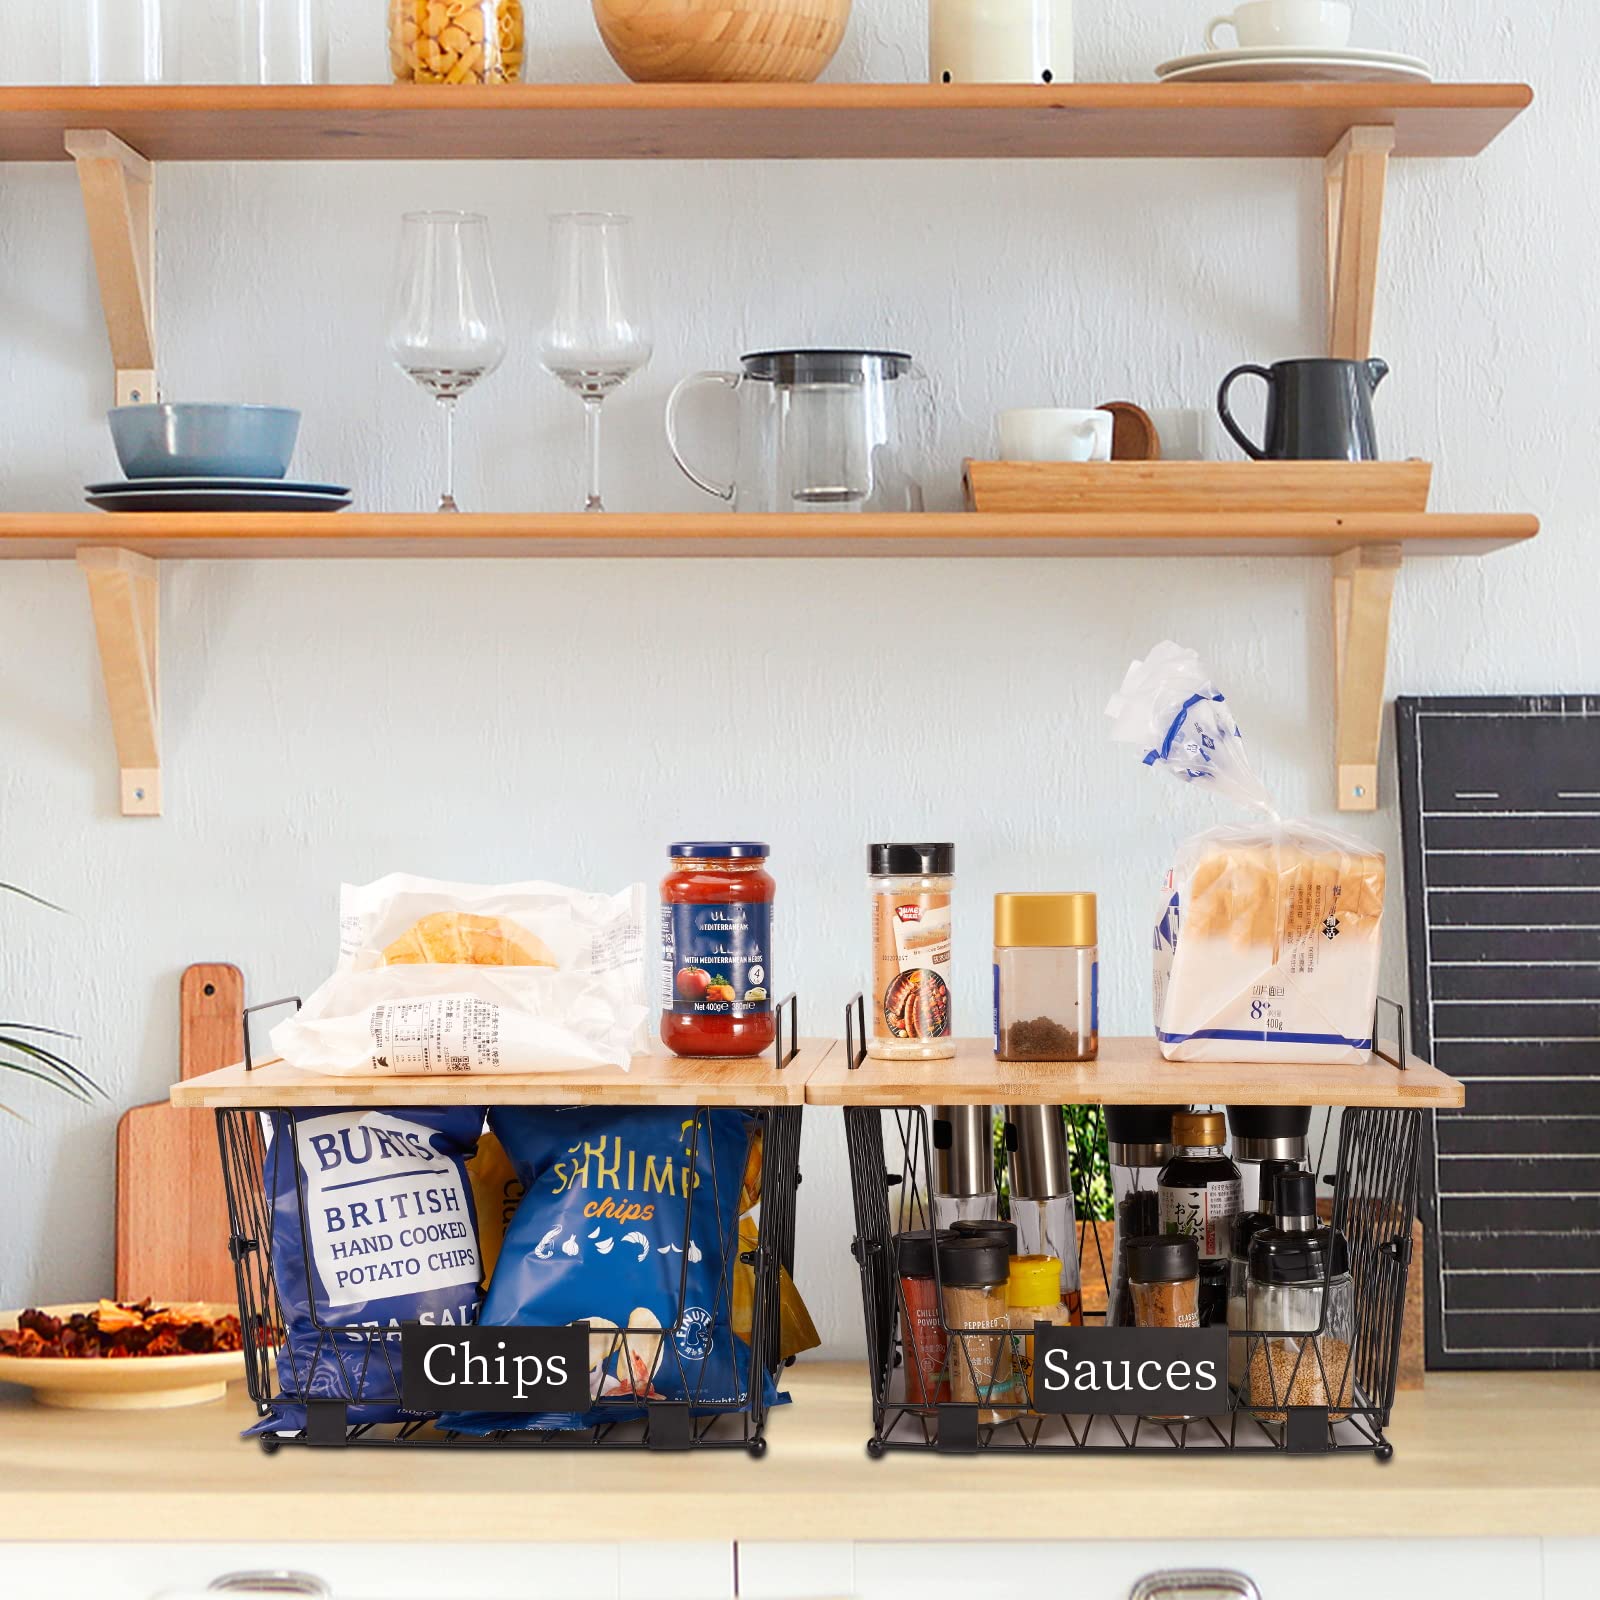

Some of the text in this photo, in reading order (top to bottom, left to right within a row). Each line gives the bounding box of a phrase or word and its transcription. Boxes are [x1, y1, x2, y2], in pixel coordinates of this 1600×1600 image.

[684, 956, 699, 964] WITH
[694, 1002, 705, 1011] Net
[309, 1125, 435, 1172] BURTS
[324, 1187, 461, 1233] BRITISH
[583, 1196, 655, 1224] chips
[330, 1221, 467, 1261] HAND COOKED
[336, 1248, 476, 1288] POTATO CHIPS
[963, 1319, 998, 1330] PEPPERED
[423, 1340, 568, 1399] Chips
[1044, 1348, 1217, 1391] Sauces
